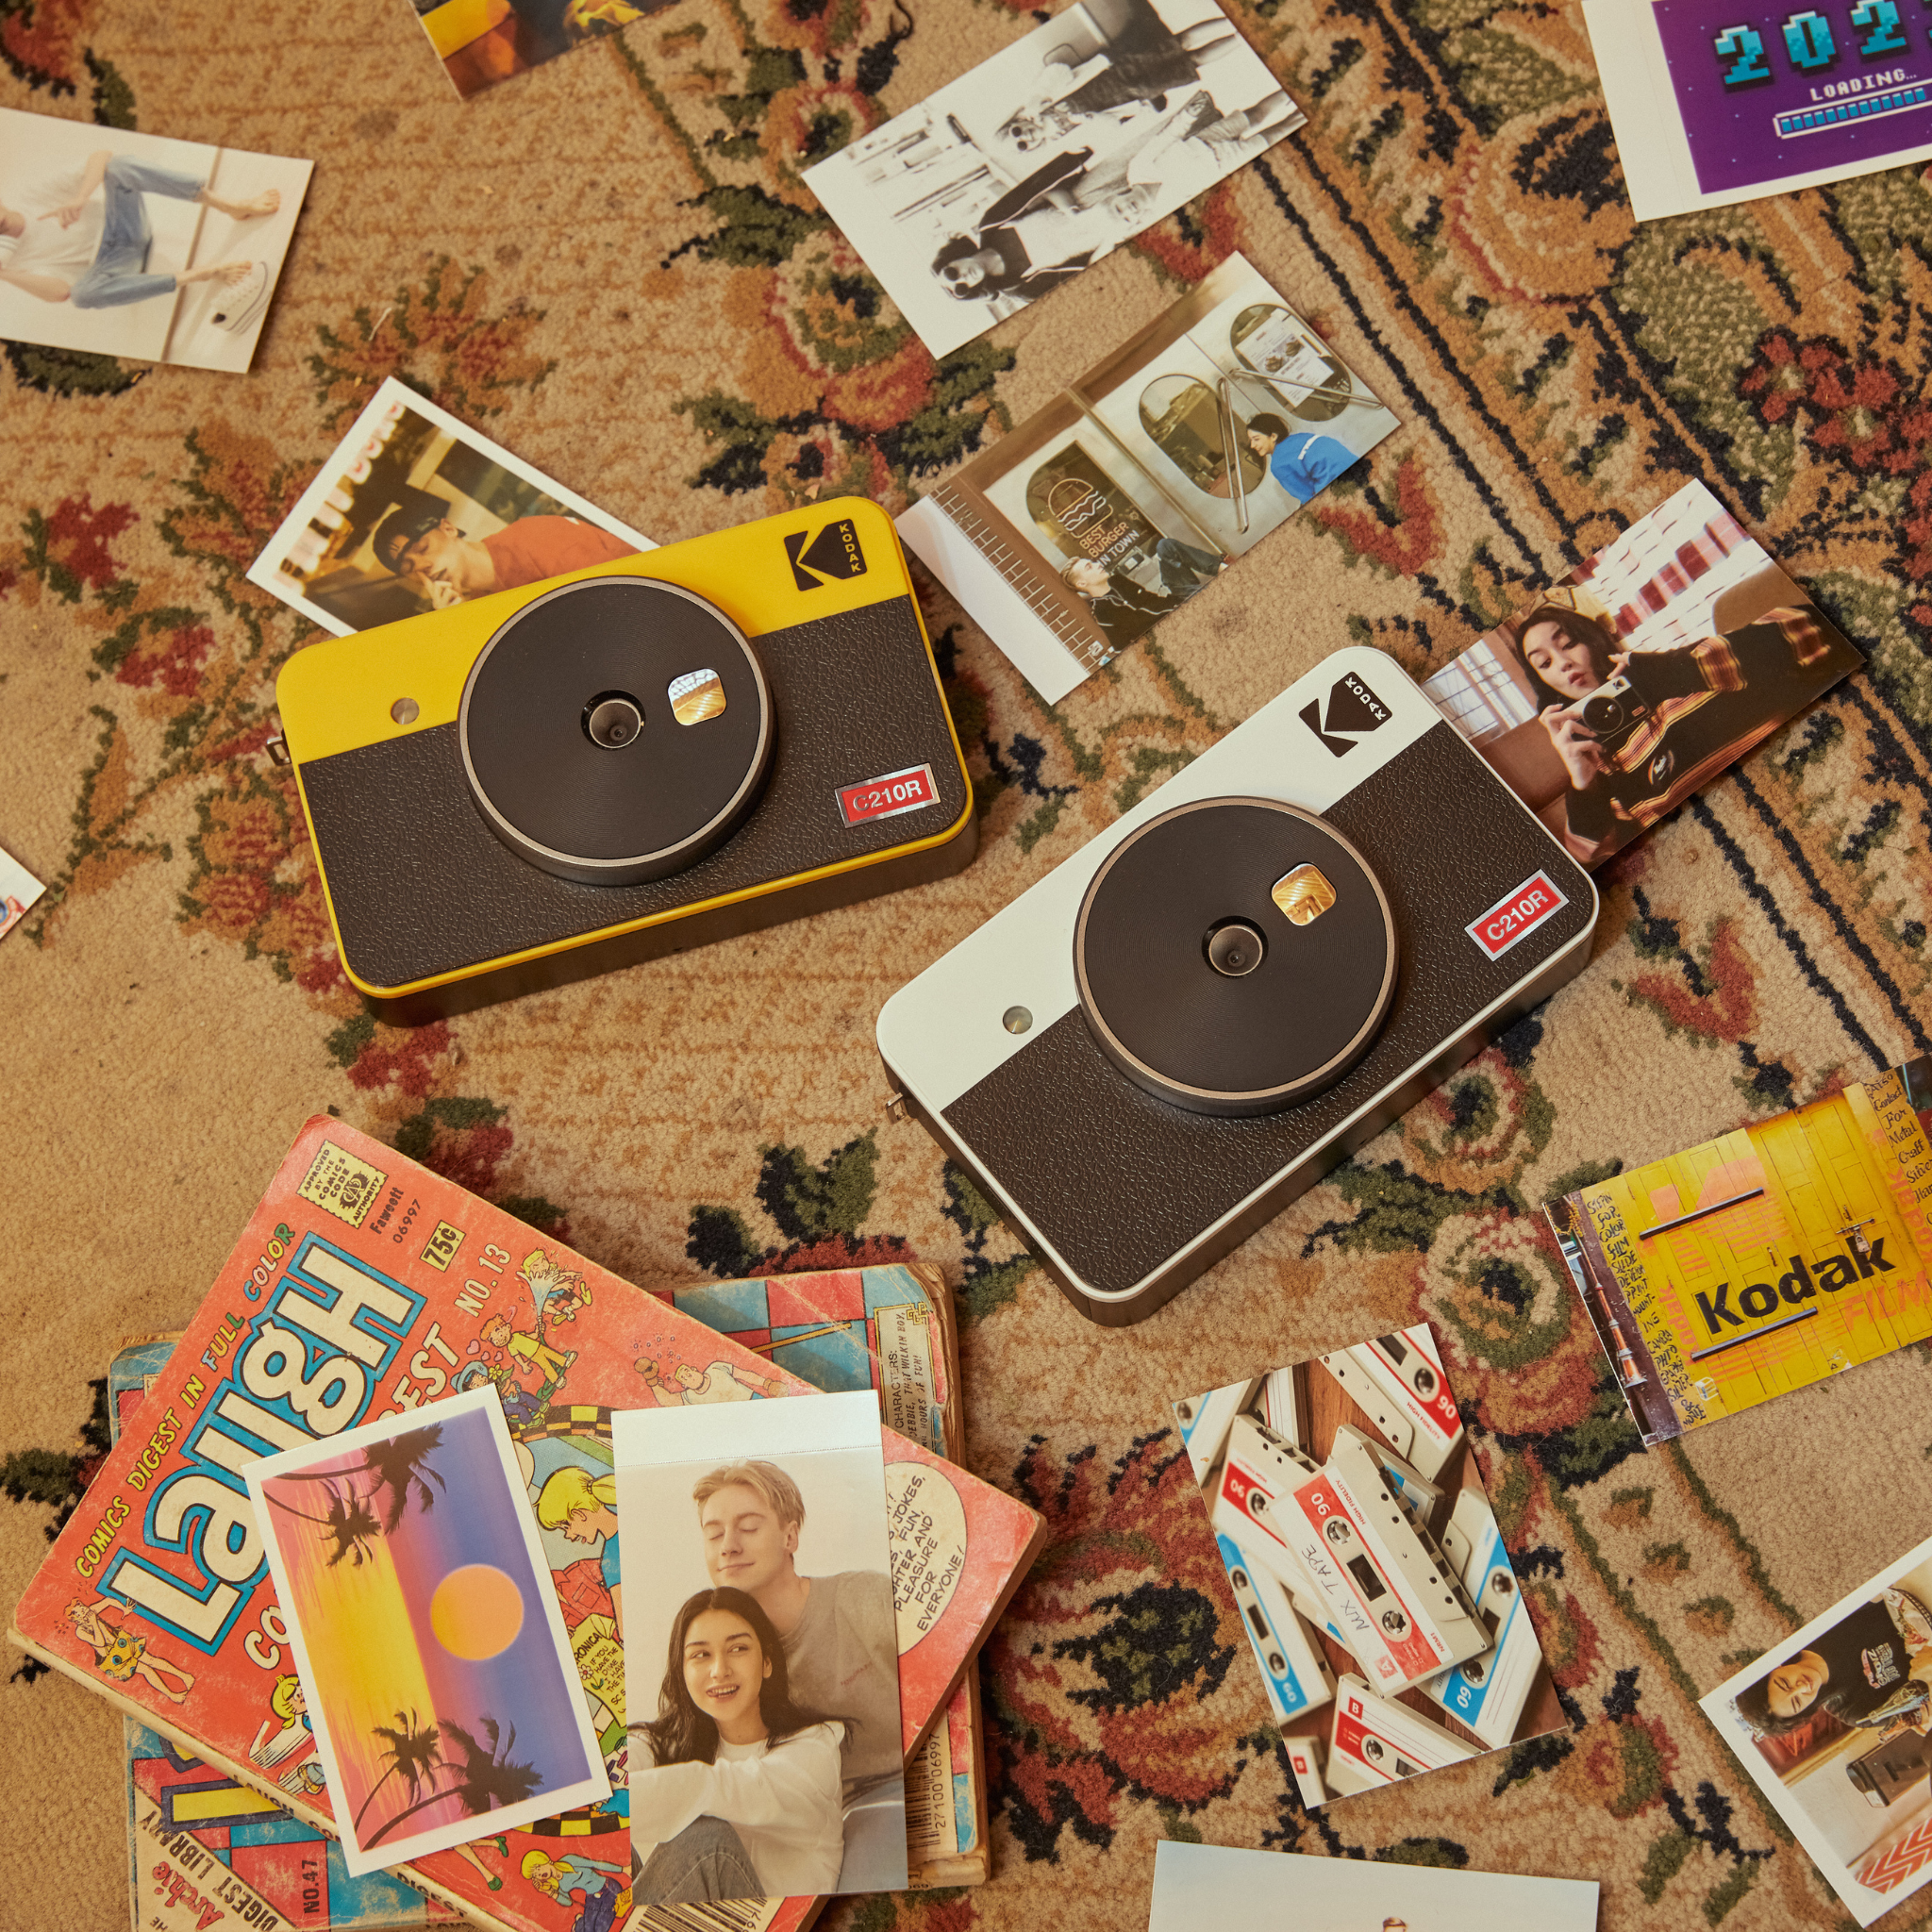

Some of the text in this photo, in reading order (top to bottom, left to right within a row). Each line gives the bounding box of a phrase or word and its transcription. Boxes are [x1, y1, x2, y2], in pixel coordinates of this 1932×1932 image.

[1714, 0, 1932, 86] 202
[839, 524, 861, 573] KODAK
[1079, 525, 1106, 550] BEST
[1088, 522, 1129, 558] BURGER
[1107, 529, 1140, 557] TOWN
[1344, 676, 1387, 721] KODAK
[853, 779, 923, 811] C210R
[1487, 890, 1549, 941] C210R
[1881, 1108, 1907, 1130] For
[1888, 1120, 1919, 1148] Metal
[304, 1149, 330, 1192] APPROVED
[314, 1159, 335, 1191] BY THE
[319, 1157, 346, 1200] COMICS
[330, 1168, 350, 1198] CODE
[1906, 1158, 1932, 1184] Silve
[353, 1175, 380, 1222] AUTHORITY
[392, 1198, 421, 1244] 06997
[1597, 1206, 1621, 1230] FOR
[1607, 1236, 1629, 1260] FILM
[453, 1242, 512, 1319] NO. 13
[1695, 1235, 1896, 1335] Kodak
[1843, 1270, 1931, 1331] FILM
[1641, 1311, 1660, 1333] ING
[75, 1223, 295, 1578] COMICS DIGEST IN FULL COLOR
[1437, 1395, 1457, 1420] 90
[892, 1474, 925, 1524] JOKES,
[1310, 1492, 1332, 1516] 90
[1335, 1479, 1367, 1525] HIGH FIDELITY
[899, 1510, 924, 1541] FUN,
[914, 1515, 933, 1548] AND
[893, 1537, 939, 1612] PLEASURE
[914, 1570, 938, 1604] FOR
[1301, 1544, 1370, 1631] MIX TAPE
[594, 1646, 618, 1674] HAVE THE
[595, 1645, 608, 1659] YOU
[607, 1681, 620, 1692] THE
[1457, 1686, 1472, 1708] 60
[1352, 1701, 1360, 1714] B
[929, 1733, 946, 1829] 27100 06997
[152, 1860, 225, 1931] Archie
